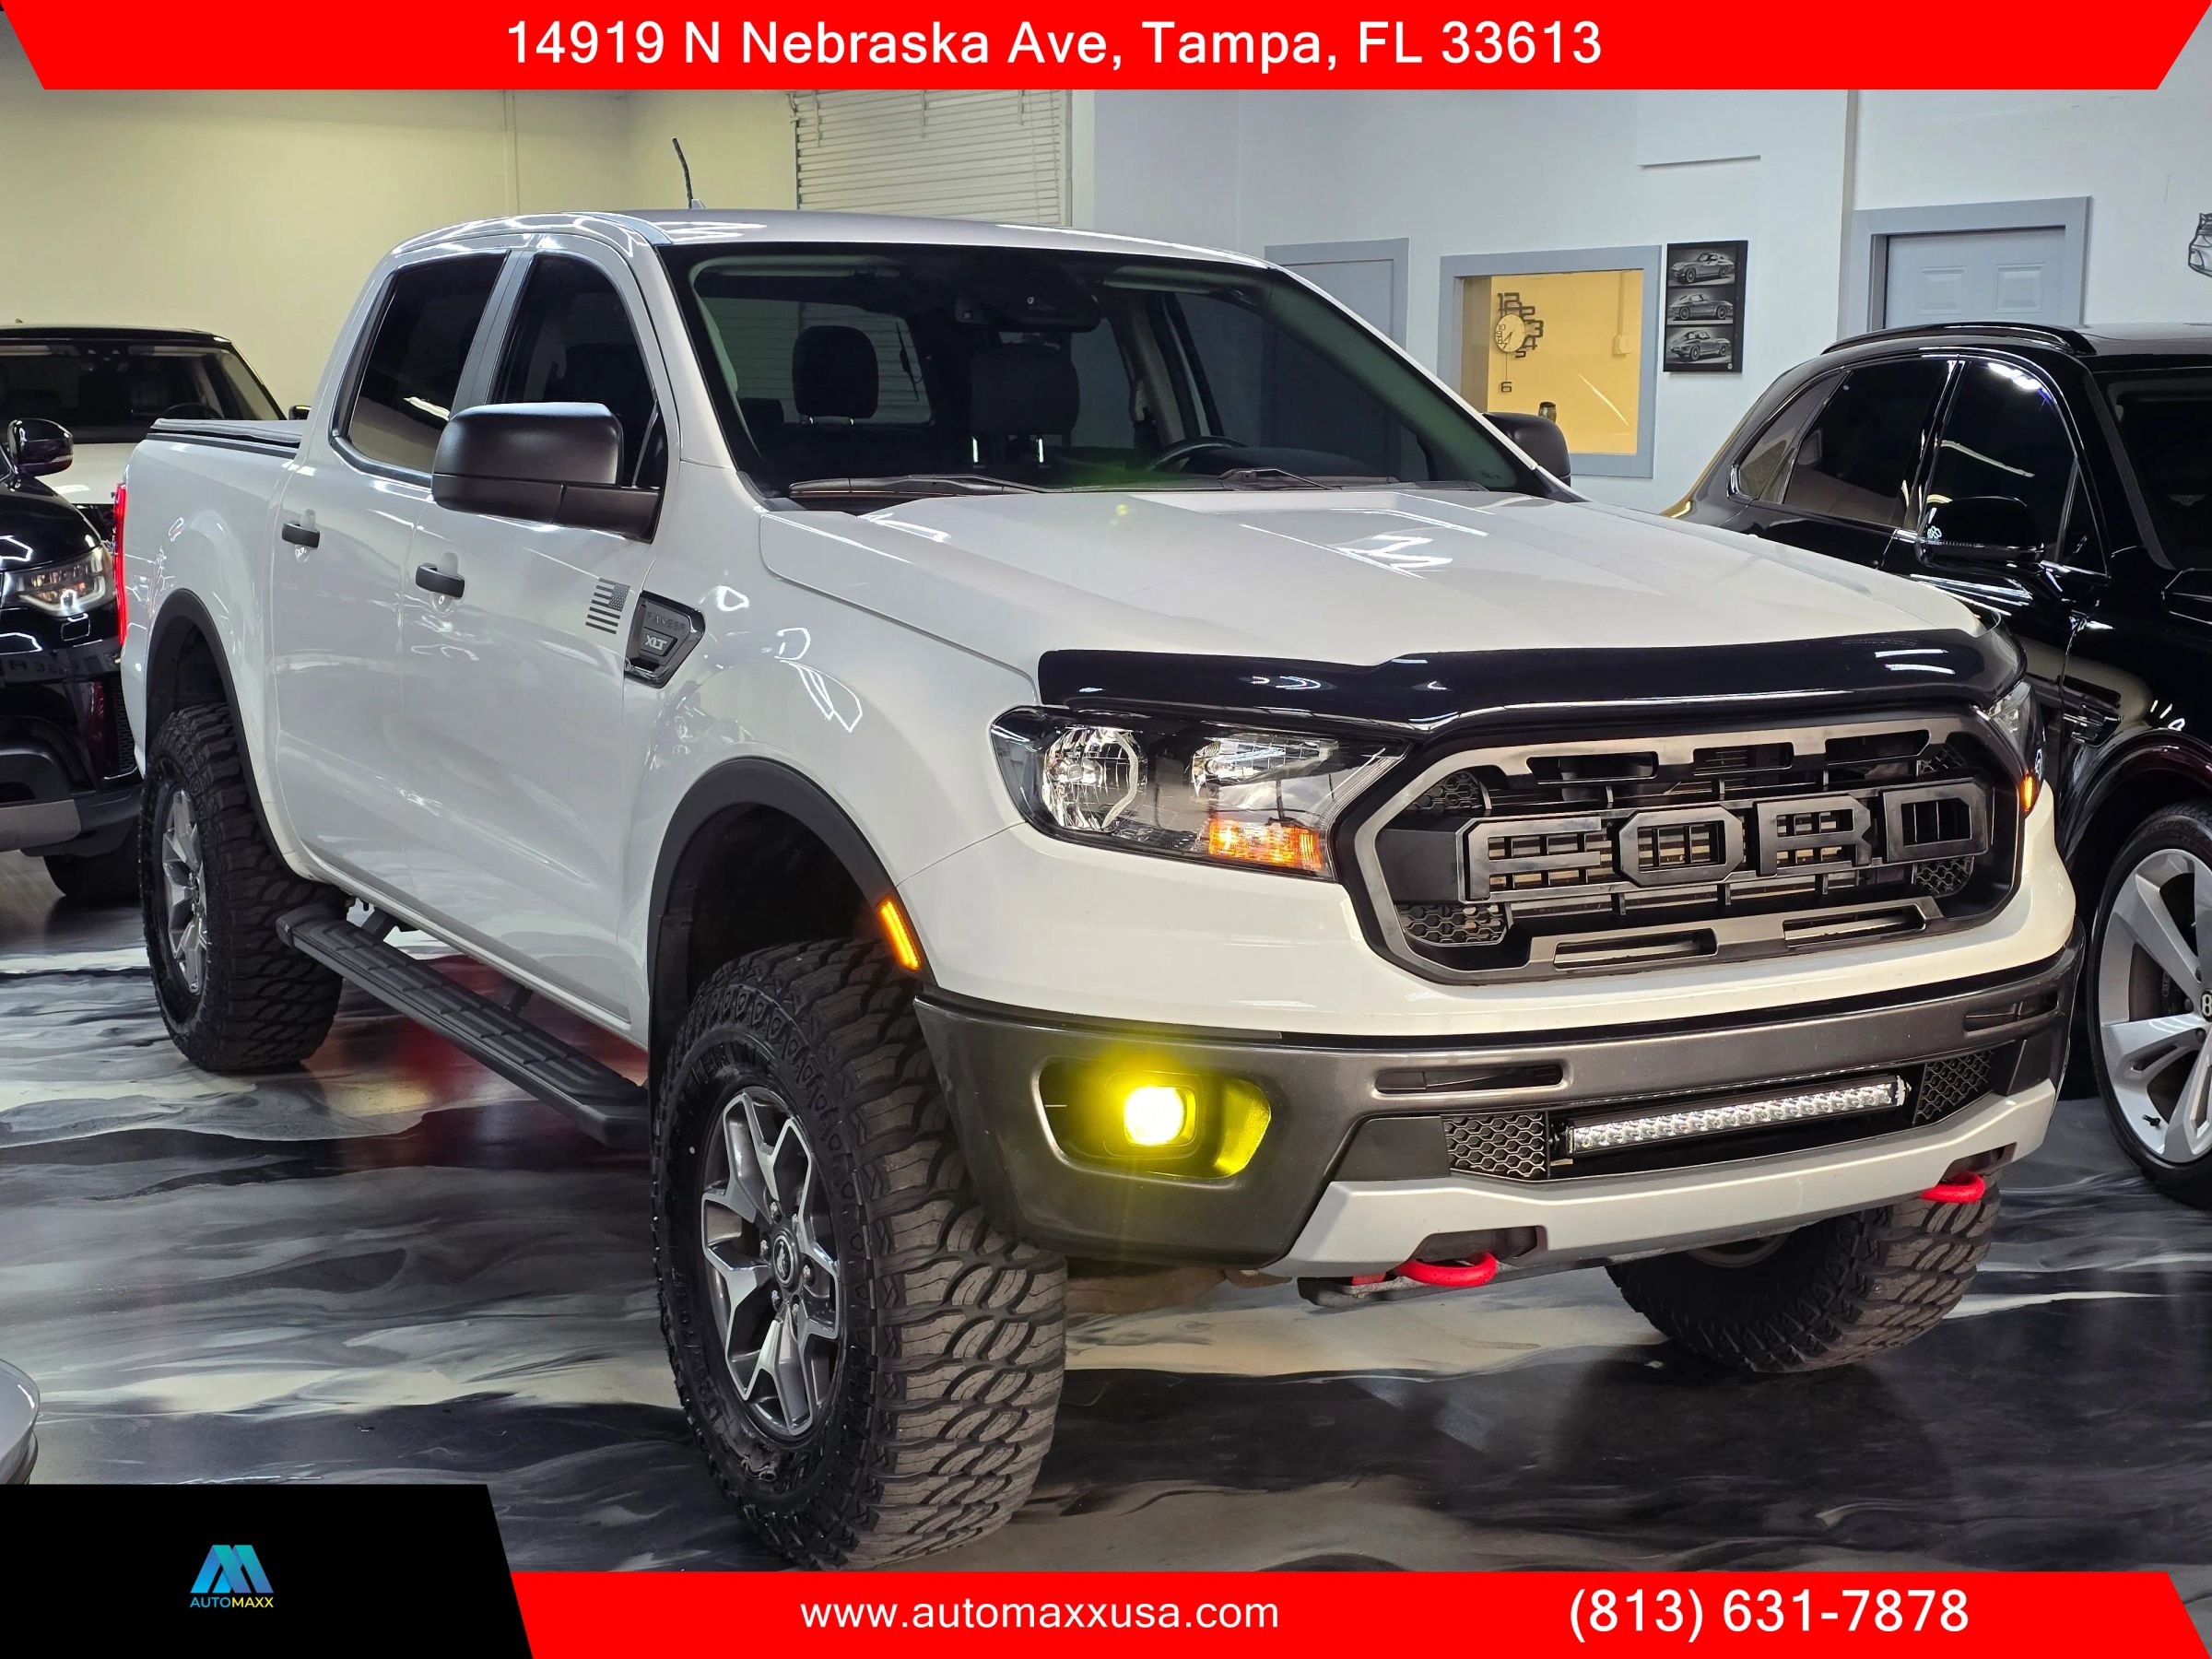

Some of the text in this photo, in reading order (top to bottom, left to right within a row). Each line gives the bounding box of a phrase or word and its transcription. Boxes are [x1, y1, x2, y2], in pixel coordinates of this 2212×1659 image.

[1500, 381, 1512, 393] 6
[645, 634, 668, 651] XLT
[1465, 777, 1989, 900] FORD
